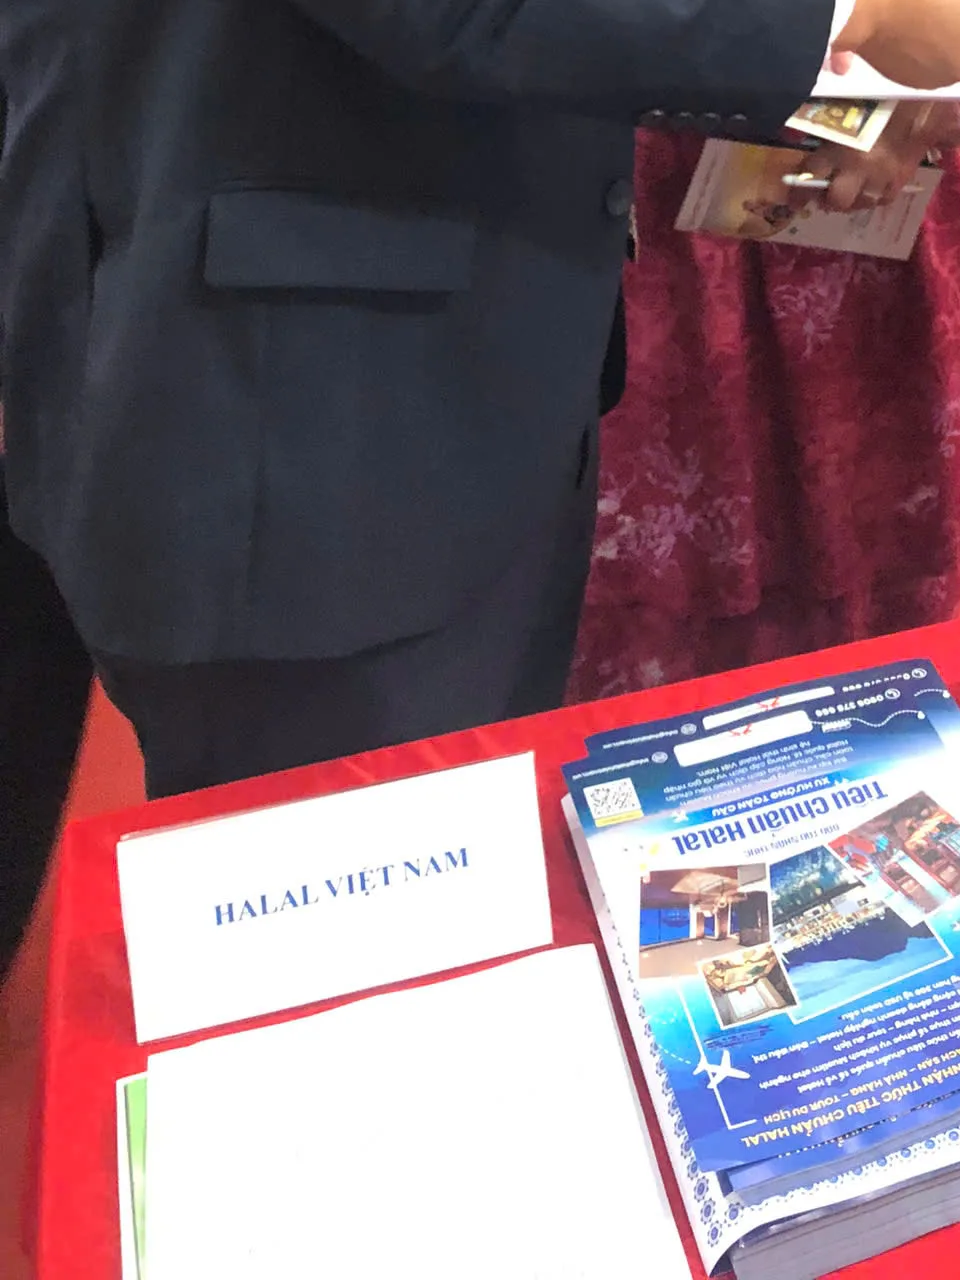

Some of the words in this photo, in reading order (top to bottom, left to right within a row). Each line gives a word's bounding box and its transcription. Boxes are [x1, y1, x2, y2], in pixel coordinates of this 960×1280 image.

[712, 804, 736, 816] CẦU
[737, 795, 769, 809] TOÀN
[672, 821, 746, 855] Halal
[215, 885, 319, 926] HALAL
[325, 864, 395, 896] VIỆT
[403, 847, 469, 882] NAM
[917, 1056, 940, 1070] SẠN
[883, 1069, 908, 1085] NHÀ
[849, 1079, 883, 1096] HÀNG
[881, 1080, 922, 1102] THỨC
[792, 1105, 809, 1116] DU
[809, 1095, 840, 1111] TOUR
[846, 1096, 880, 1115] TIÊU
[763, 1109, 791, 1124] LỊCH
[791, 1109, 845, 1136] CHUẨN
[741, 1126, 790, 1147] HALAL
